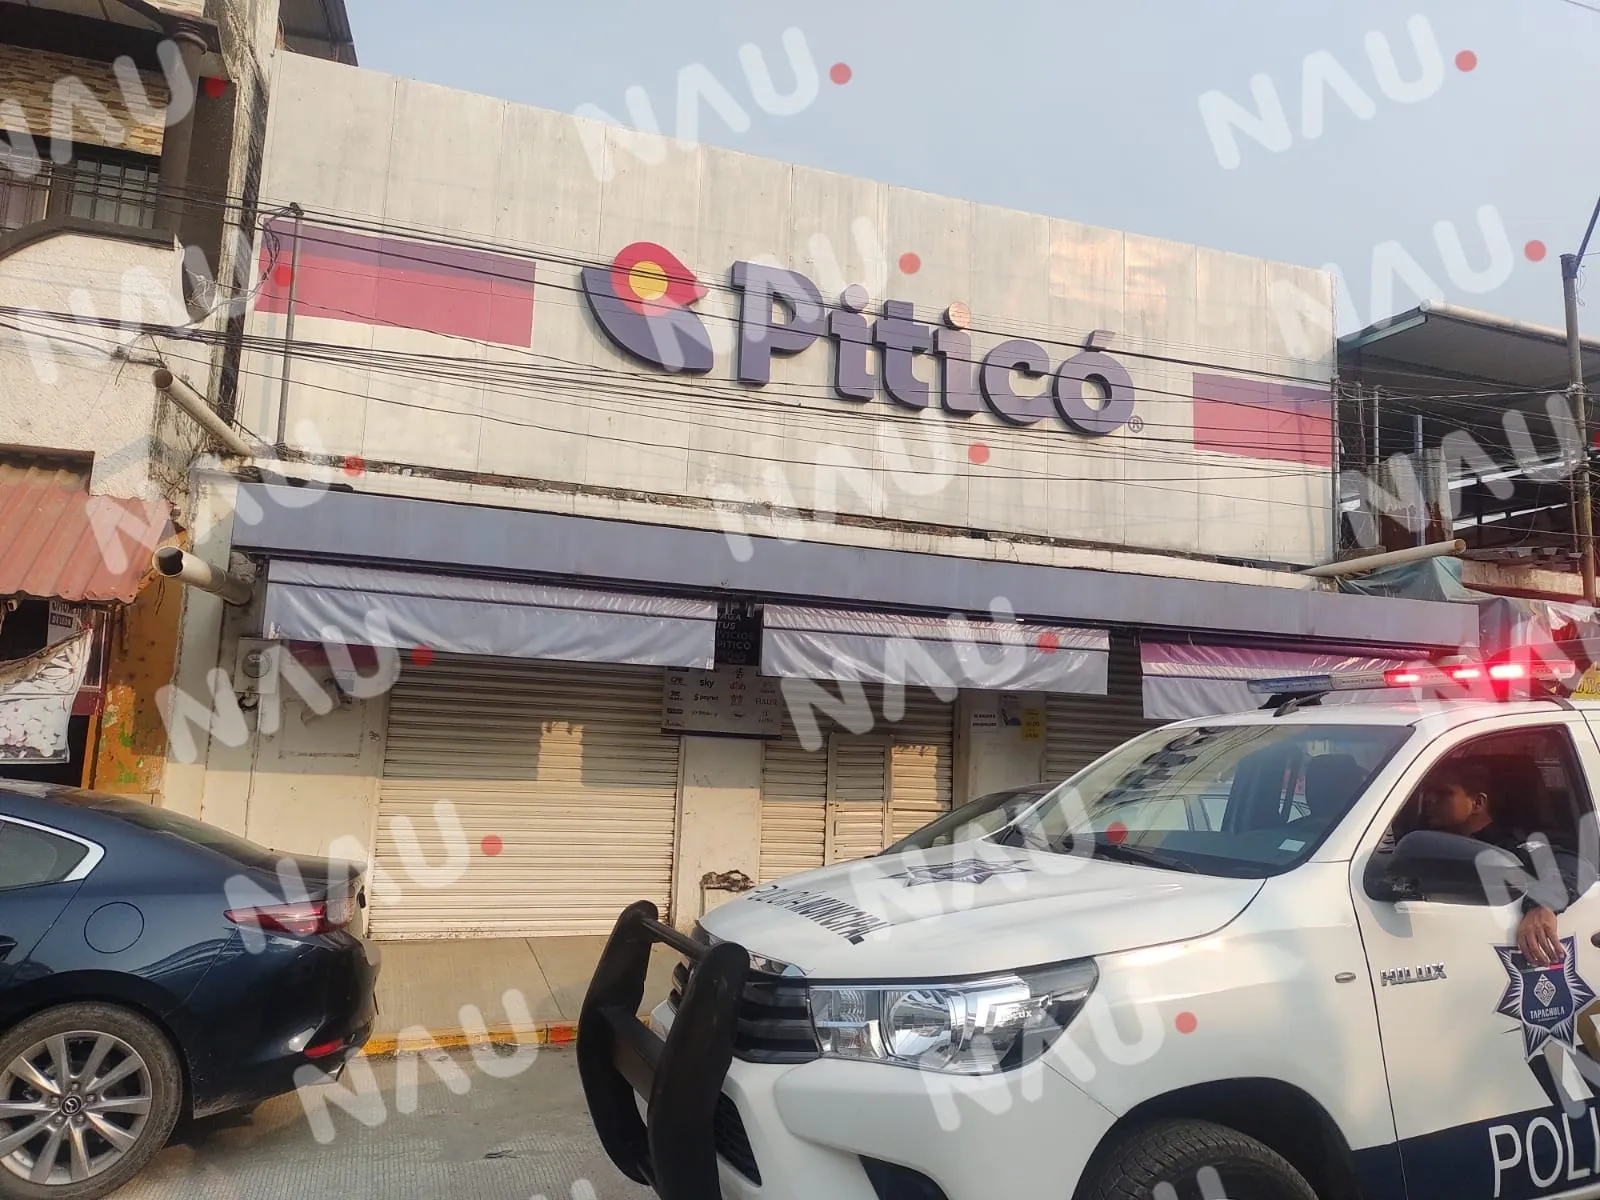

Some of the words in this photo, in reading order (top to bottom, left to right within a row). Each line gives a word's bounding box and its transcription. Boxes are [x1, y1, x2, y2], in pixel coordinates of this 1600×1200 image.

[731, 260, 1136, 437] Piticó
[700, 679, 715, 688] sky
[1379, 962, 1448, 987] HILUX
[1530, 1006, 1565, 1020] TAPACHULA
[1488, 1107, 1600, 1198] POLI
